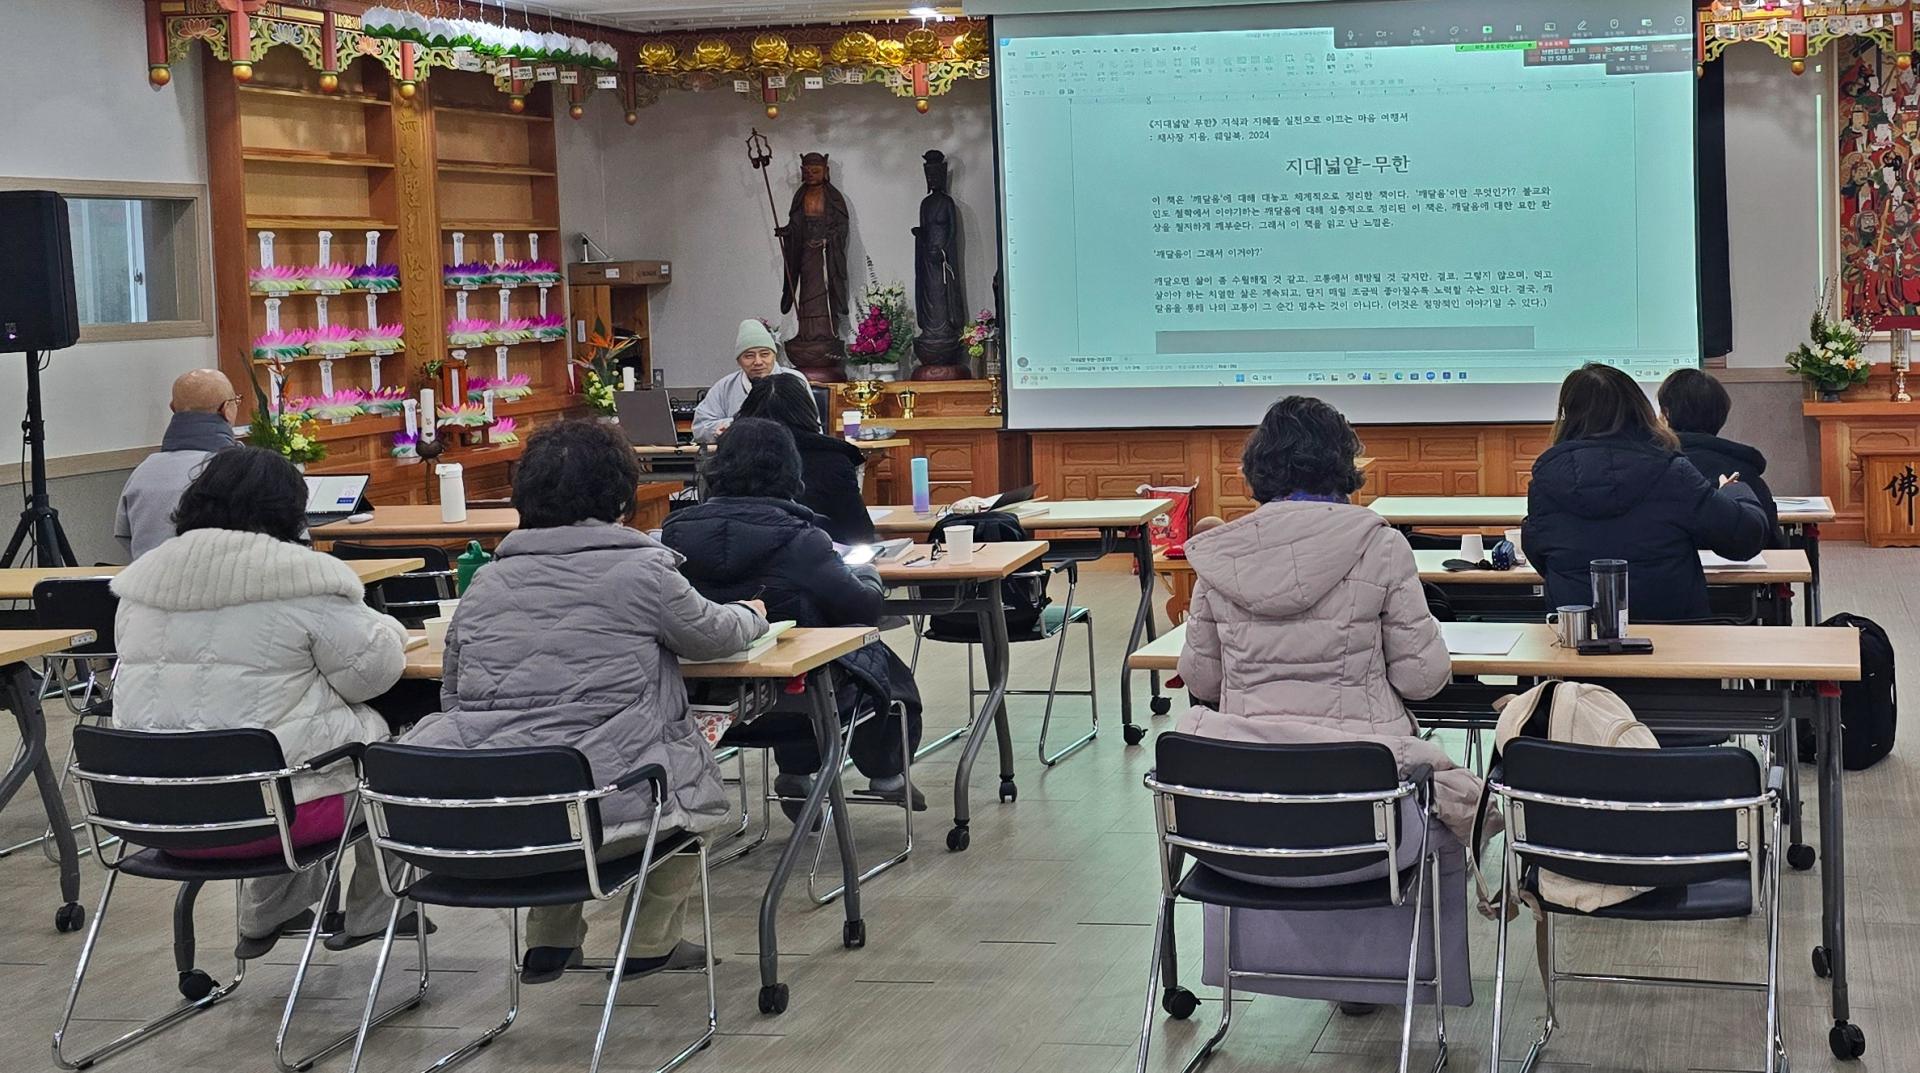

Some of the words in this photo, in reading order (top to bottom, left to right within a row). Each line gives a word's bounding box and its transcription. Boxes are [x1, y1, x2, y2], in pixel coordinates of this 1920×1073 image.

[1222, 118, 1248, 126] 지식과
[1285, 116, 1321, 125] 실천으로
[1326, 115, 1353, 123] 이끄는
[1358, 114, 1375, 123] 마음
[1381, 113, 1409, 122] 여행서
[1248, 131, 1270, 139] 2024
[1286, 155, 1410, 175] 지대넓얕-무한
[1152, 196, 1161, 205] 이
[1166, 196, 1185, 204] 책은
[1238, 194, 1256, 203] 대해
[1262, 193, 1288, 202] 대놓고
[1346, 191, 1373, 201] 정리한
[1378, 190, 1409, 199] 책이다.
[1473, 187, 1516, 197] 무엇인가?
[1522, 186, 1551, 196] 불교와
[1152, 209, 1171, 218] 인도
[1175, 208, 1210, 218] 철학에서
[1215, 207, 1260, 217] 이야기하는
[1264, 206, 1300, 216] 깨달음에
[1306, 206, 1324, 214] 대해
[1379, 204, 1406, 213] 정리된
[1412, 204, 1420, 212] 이
[1452, 202, 1489, 212] 깨달음에
[1494, 201, 1514, 210] 대한
[1152, 223, 1170, 232] 상을
[1258, 220, 1286, 229] 그래서
[1291, 220, 1300, 229] 이
[1304, 220, 1321, 229] 책을
[1327, 219, 1345, 229] 읽고
[1350, 219, 1358, 228] 난
[1197, 249, 1224, 258] 그래서
[1228, 248, 1263, 257] 이거야?'
[1154, 277, 1190, 286] 깨달으면
[1195, 276, 1213, 285] 삶이
[1273, 275, 1282, 284] 것
[1313, 274, 1349, 283] 고통에서
[1386, 273, 1396, 282] 것
[1464, 271, 1491, 280] 그렇지
[1534, 271, 1553, 279] 먹고
[1156, 290, 1182, 300] 살아야
[1186, 290, 1204, 299] 하는
[1208, 290, 1235, 299] 치열한
[1240, 289, 1258, 298] 삶은
[1306, 288, 1324, 297] 단지
[1328, 288, 1346, 297] 매일
[1434, 285, 1461, 295] 노력할
[1466, 285, 1485, 294] 수는
[1490, 285, 1511, 294] 있다.
[1155, 304, 1182, 313] 달음을
[1186, 304, 1204, 313] 통해
[1209, 303, 1227, 312] 나의
[1231, 302, 1257, 312] 고통이
[1262, 302, 1272, 311] 그
[1276, 302, 1294, 311] 순간
[1299, 302, 1326, 311] 멈추는
[1331, 301, 1348, 310] 것이
[1353, 300, 1384, 310] 아니다.
[1388, 300, 1418, 309] (이것은
[1465, 298, 1502, 308] 이야기일
[1507, 298, 1517, 307] 수
[1522, 298, 1547, 307] 있다.)
[1882, 465, 1920, 526] 佛
